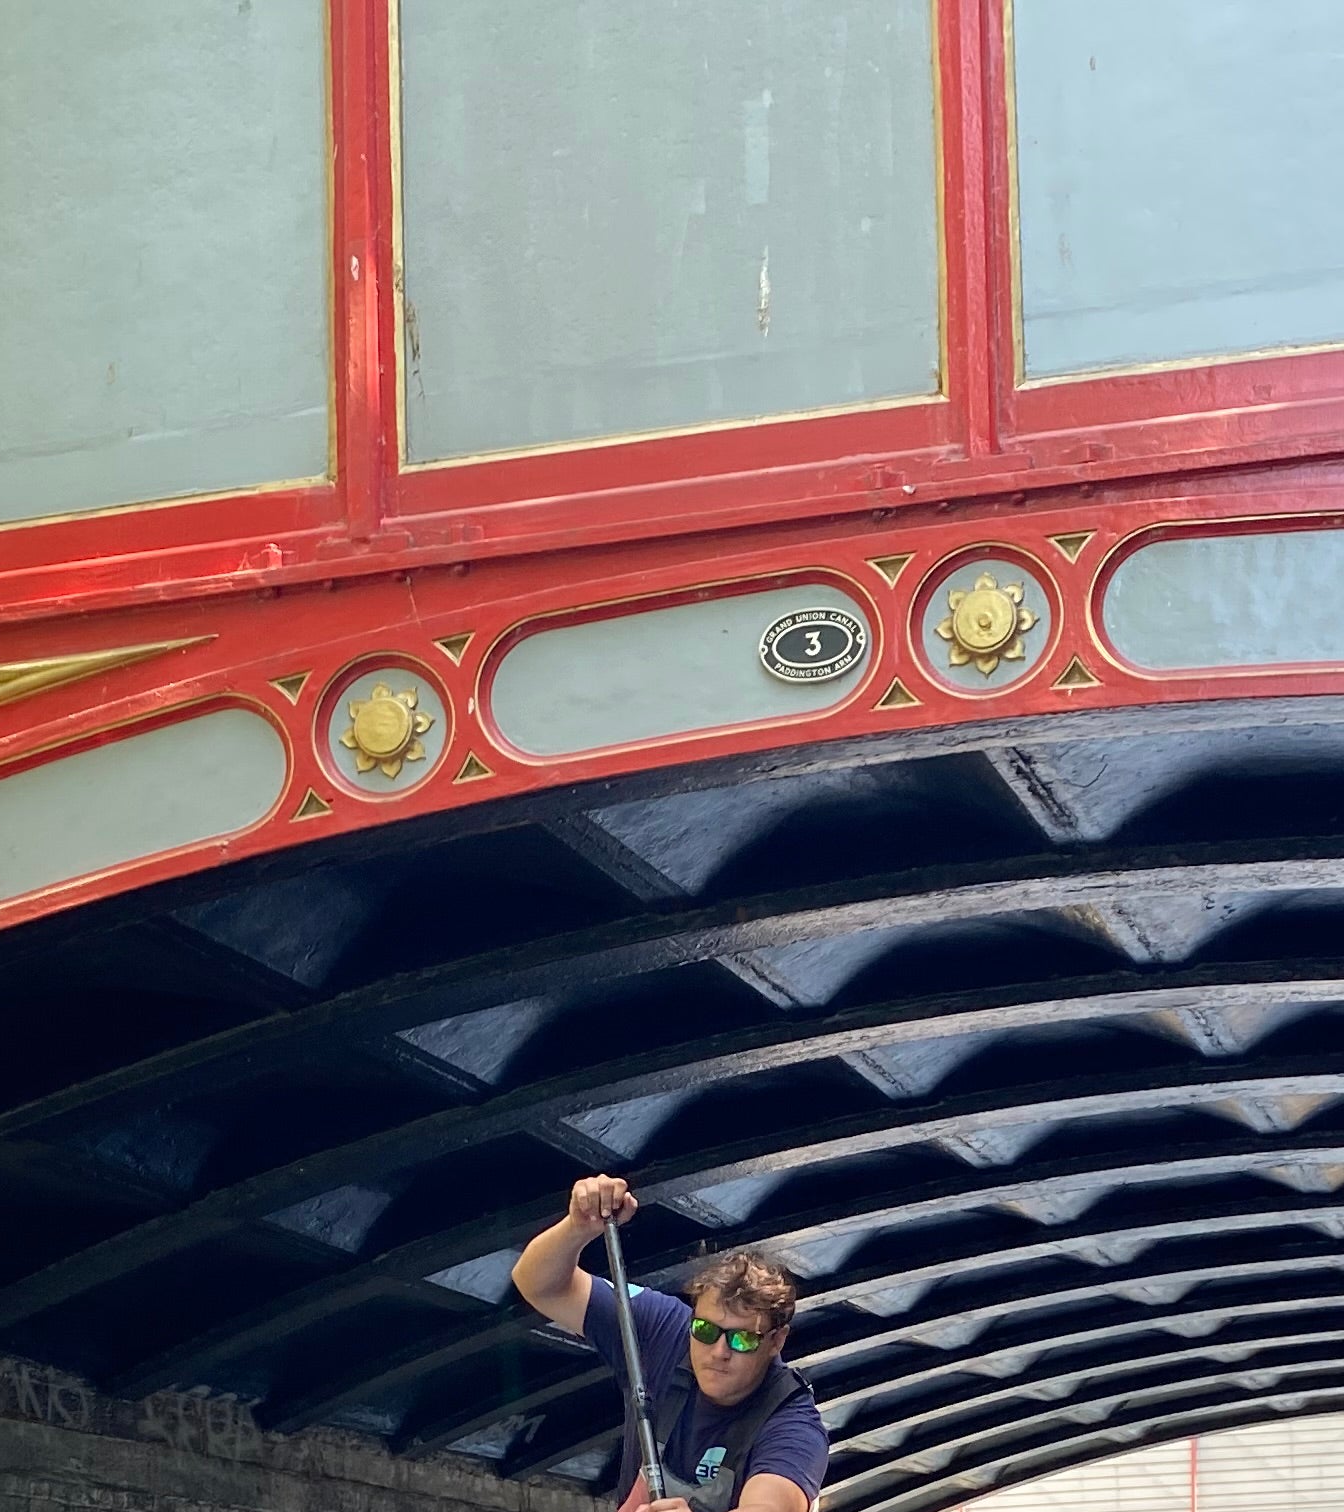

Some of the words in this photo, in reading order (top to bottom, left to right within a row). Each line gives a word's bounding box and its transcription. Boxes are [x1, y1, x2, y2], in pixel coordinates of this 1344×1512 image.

[766, 618, 793, 643] GRAND
[796, 613, 826, 623] UNION
[830, 614, 858, 632] CANAL
[805, 632, 822, 656] 3
[775, 663, 831, 677] PADDINGTON
[835, 656, 853, 671] ARM
